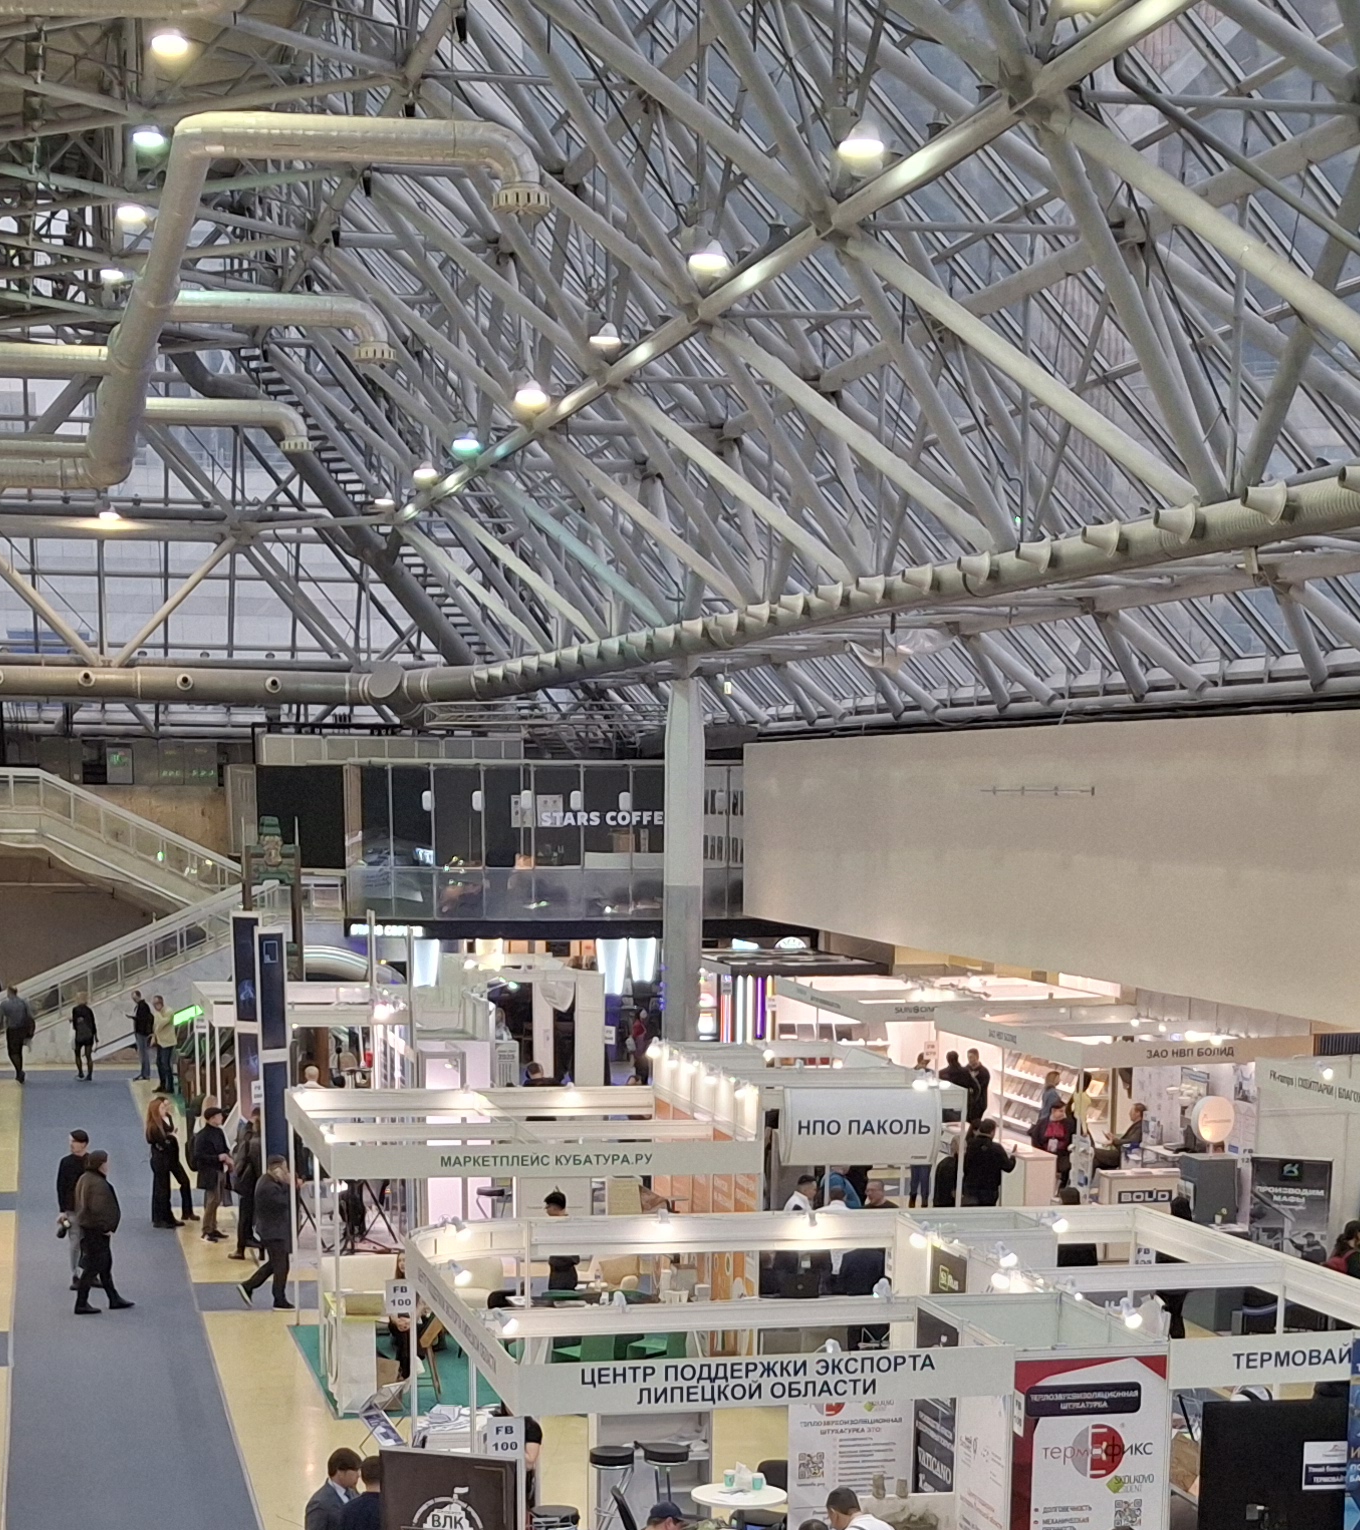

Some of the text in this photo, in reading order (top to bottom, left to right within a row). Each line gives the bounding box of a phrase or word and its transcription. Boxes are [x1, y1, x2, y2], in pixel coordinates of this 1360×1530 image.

[541, 811, 600, 826] STARS
[1146, 1046, 1235, 1059] ЗАО НВП БОЛИД
[798, 1118, 932, 1136] НПО ПАКОЛЬ
[440, 1152, 652, 1168] МАРКЕТПЛЕЙС КУБАТУРА.РУ
[393, 1286, 408, 1294] FB
[390, 1298, 412, 1306] 100
[1232, 1342, 1352, 1370] ТЕРМОВАЙ
[580, 1354, 936, 1390] ЦЕНТР ПОДДЕРЖКИ ЭКСПОРТА
[636, 1378, 877, 1406] ЛИПЕЦКОЙ ОБЛАСТИ
[496, 1426, 514, 1436] FB
[492, 1442, 518, 1451] 100
[431, 1514, 465, 1530] ВЛК
